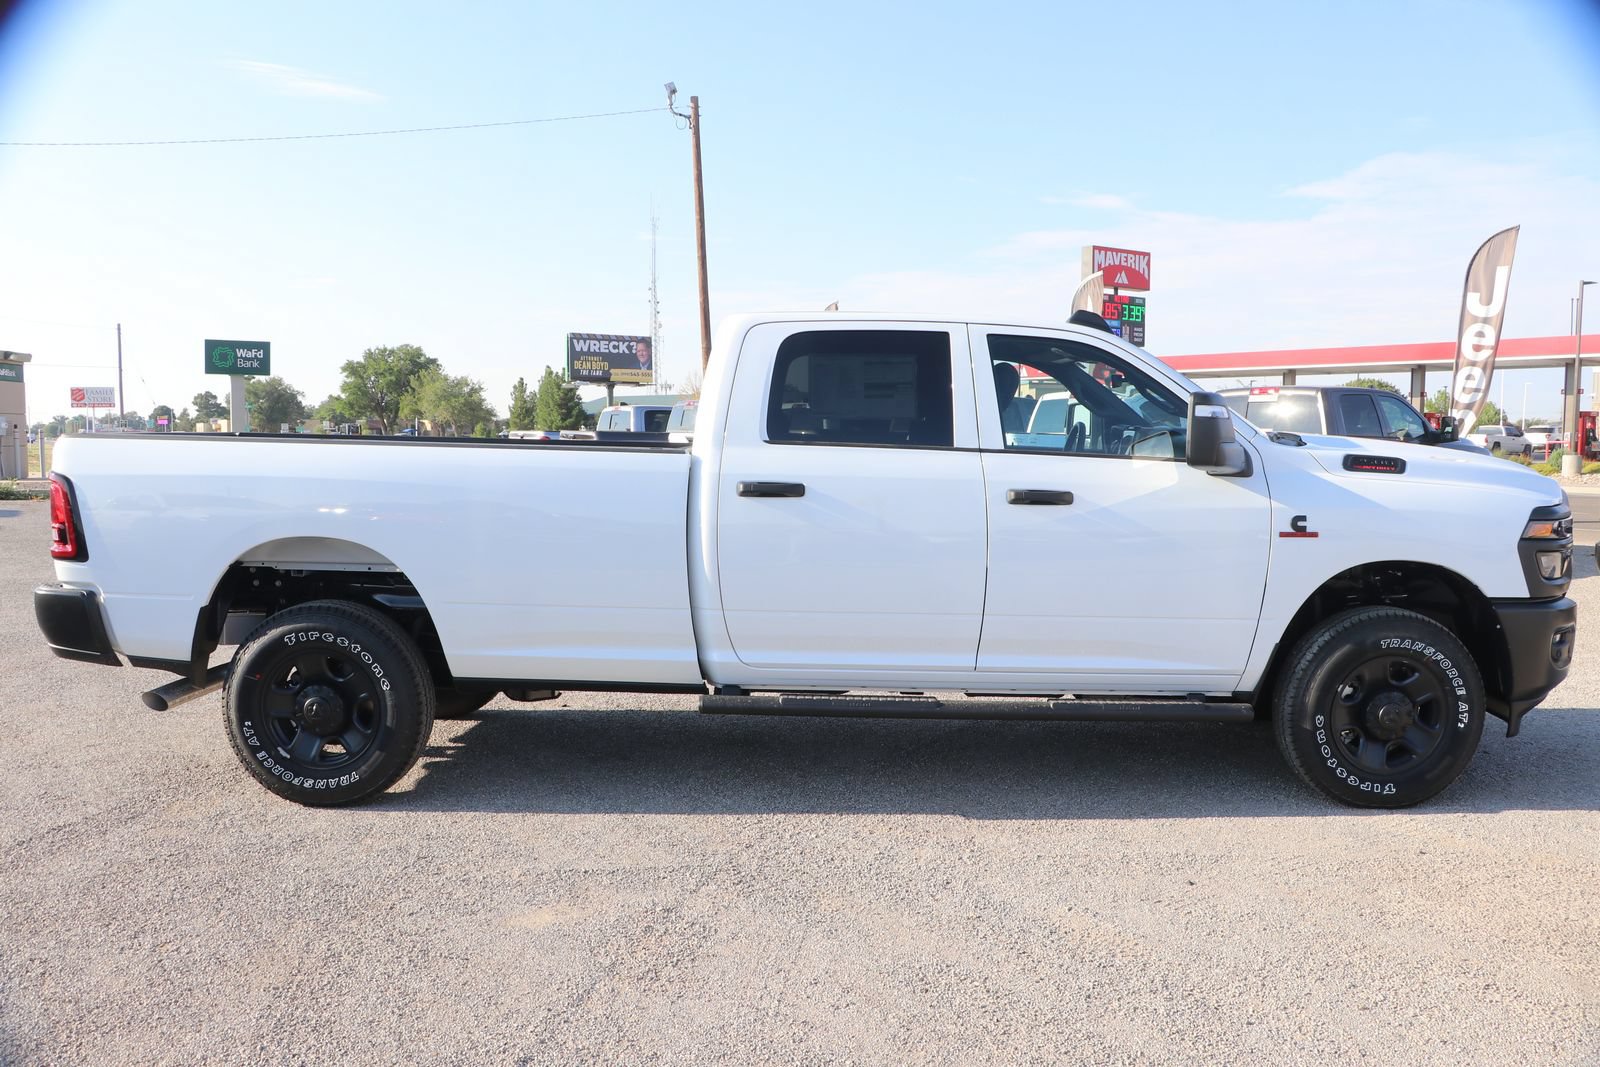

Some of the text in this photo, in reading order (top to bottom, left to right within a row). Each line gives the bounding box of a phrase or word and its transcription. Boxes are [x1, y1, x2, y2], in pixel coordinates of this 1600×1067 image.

[1094, 249, 1149, 280] MAVERIK
[573, 339, 637, 353] WRECK?
[236, 348, 264, 359] WaFd
[237, 359, 260, 368] Bank
[574, 361, 608, 370] DEAN BOYD
[86, 388, 113, 396] FAMILY
[1381, 638, 1467, 696] TRANSFORCE
[256, 751, 360, 789] TRANSFORCE
